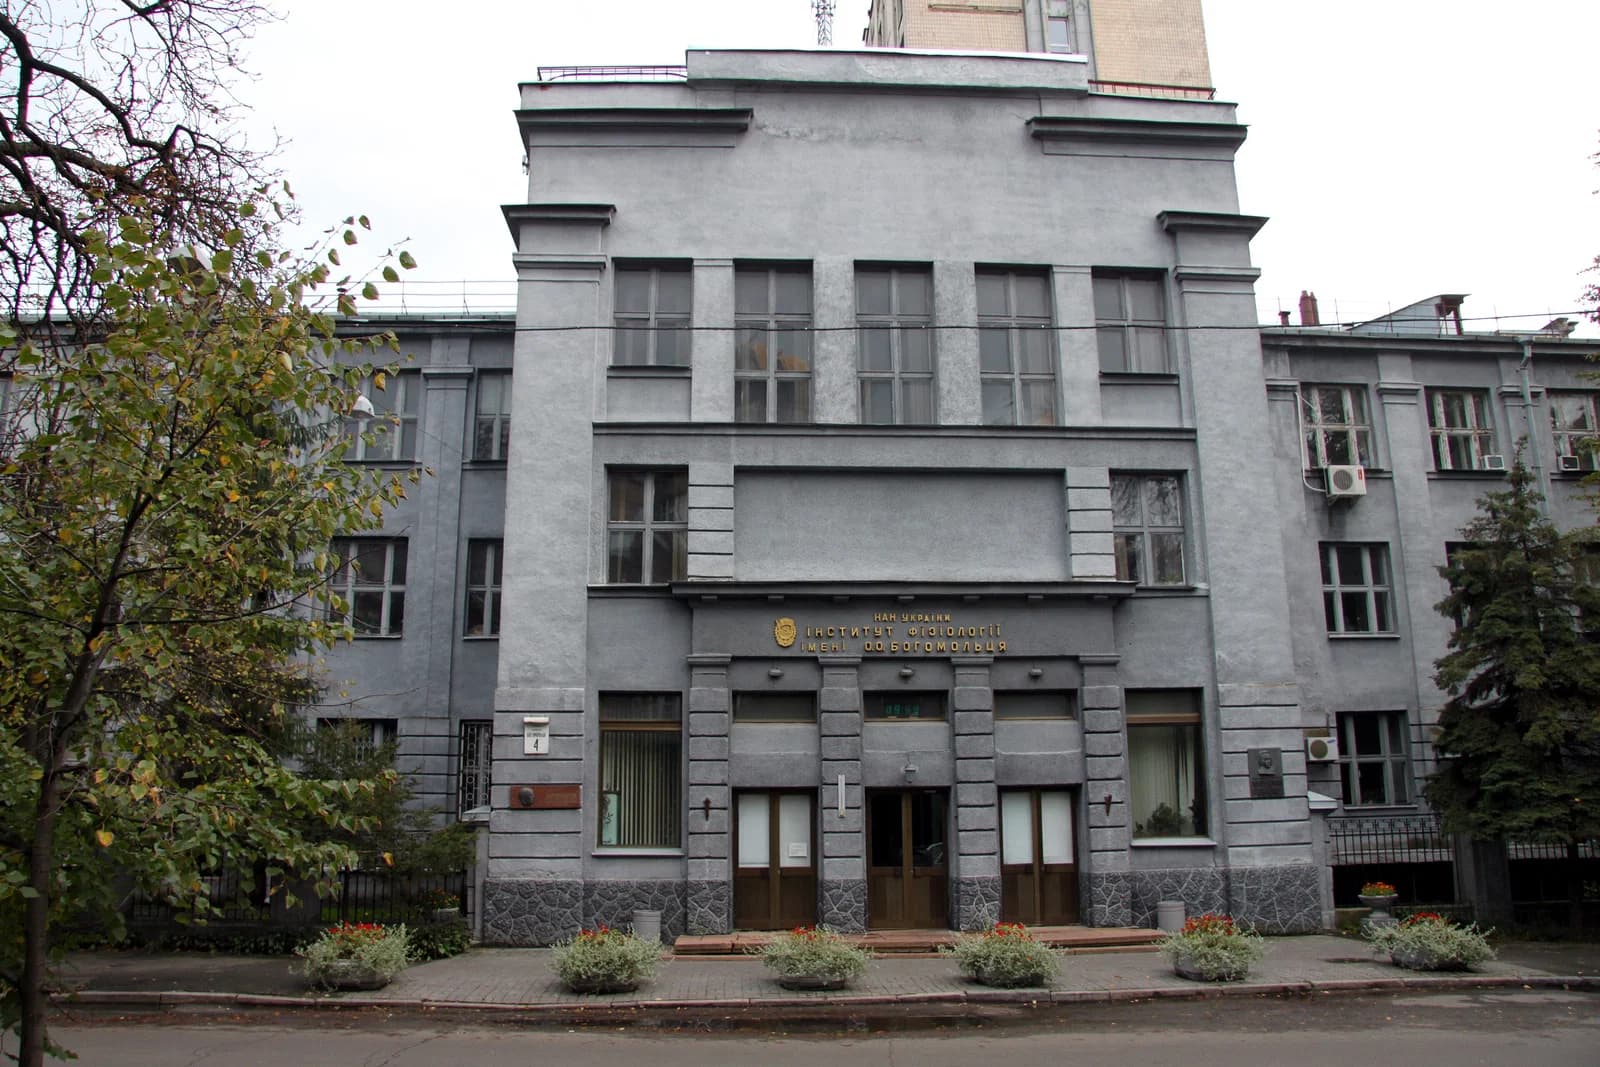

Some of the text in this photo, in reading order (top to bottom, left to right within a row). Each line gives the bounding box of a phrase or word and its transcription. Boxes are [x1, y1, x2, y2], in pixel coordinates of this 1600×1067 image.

[874, 612, 896, 622] НАН
[806, 624, 1001, 637] ІНСТИТУТ ФІЗІОЛОГІЇ
[801, 640, 846, 652] ІМЕНІ
[533, 738, 539, 751] 4
